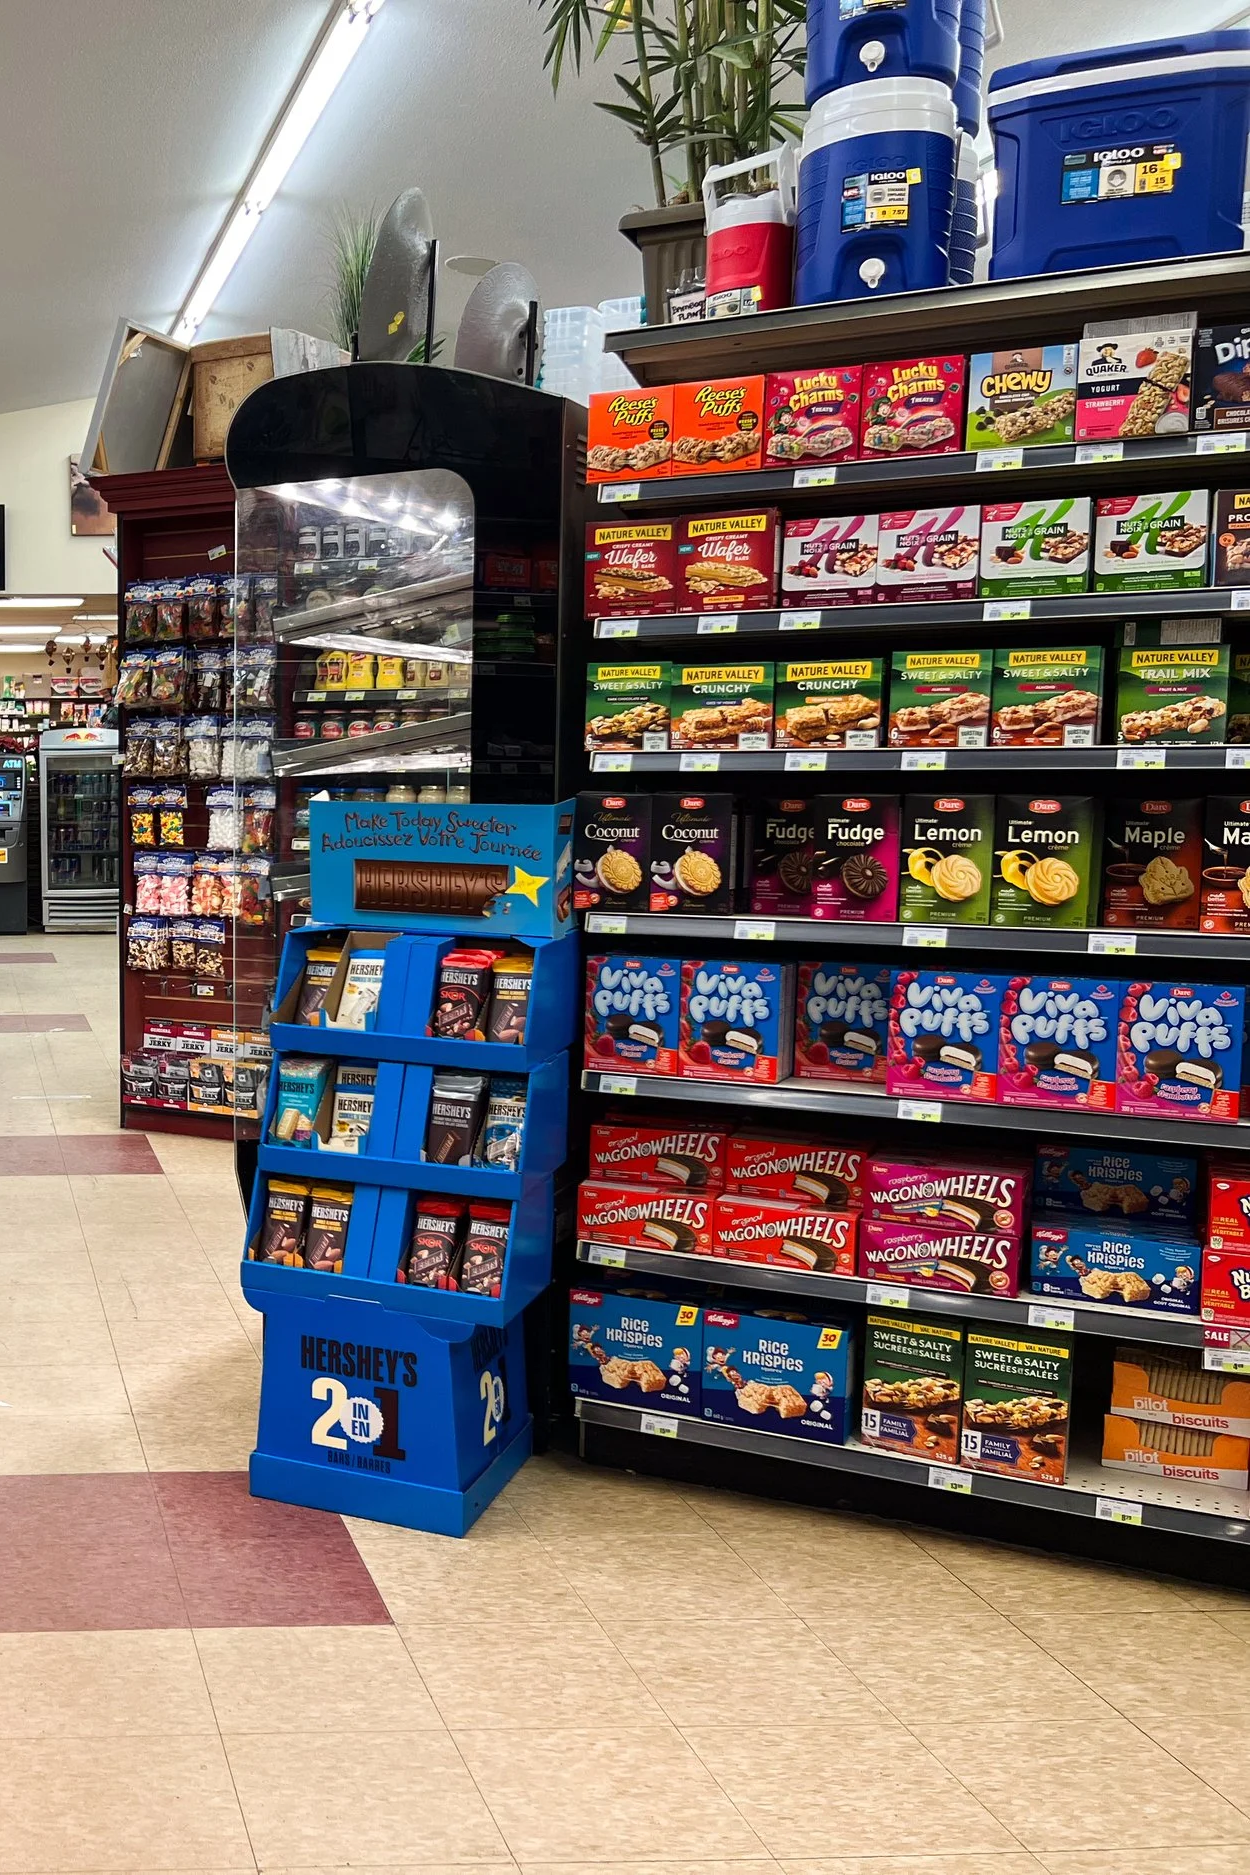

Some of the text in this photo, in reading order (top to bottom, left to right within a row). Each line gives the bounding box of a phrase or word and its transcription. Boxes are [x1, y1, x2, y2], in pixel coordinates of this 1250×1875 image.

[1061, 107, 1178, 143] IGLOO
[1094, 147, 1144, 162] IGLOO
[871, 172, 905, 181] IGLOO
[1142, 164, 1158, 174] 16
[892, 361, 938, 381] Lucky
[1086, 363, 1128, 376] QUAKER
[793, 373, 837, 391] Lucky
[1091, 384, 1120, 394] YOGURT
[695, 386, 746, 403] Reese's
[887, 378, 945, 403] Charms
[608, 396, 657, 413] Reese's
[789, 388, 844, 412] Charms
[1085, 398, 1124, 409] STRAWBERRY
[700, 401, 742, 418] Puffs
[614, 410, 654, 427] Puffs
[692, 518, 763, 533] NATURE VALLEY
[1034, 525, 1064, 535] GRAIN
[1150, 519, 1181, 529] GRAIN
[599, 527, 667, 541] NATURE VALLEY
[926, 534, 955, 543] GRAIN
[697, 542, 751, 561] Wafer
[829, 541, 856, 551] GRAIN
[605, 550, 657, 569] Wafer
[910, 656, 975, 665] NATURE VALLEY
[1013, 653, 1082, 664] NATURE VALLEY
[1136, 652, 1214, 663] NATURE VALLEY
[601, 667, 657, 677] NATURE VALLEY
[687, 669, 760, 681] NATURE VALLEY
[791, 665, 867, 677] NATURE VALLEY
[901, 671, 936, 680] SWEET
[949, 671, 982, 679] SALTY
[1003, 669, 1041, 678] SWEET
[1054, 667, 1089, 677] SALTY
[1139, 668, 1211, 679] TRAIL MIX
[594, 682, 625, 690] SWEET
[632, 681, 662, 690] SALTY
[693, 684, 751, 694] CRUNCHY
[797, 680, 858, 690] CRUNCHY
[891, 728, 898, 739] 6
[3, 760, 21, 768] ATM
[605, 799, 623, 807] Dare
[683, 799, 701, 807] Dare
[846, 801, 867, 809] Dare
[938, 801, 960, 810] Dare
[1033, 802, 1057, 811] Dare
[344, 812, 518, 837] Make Today Sweeter
[585, 824, 640, 841] Coconut
[662, 825, 719, 842] Coconut
[766, 824, 814, 843] Fudge
[827, 824, 884, 845] Fudge
[914, 825, 982, 841] Lemon
[1008, 826, 1079, 843] Lemon
[1125, 827, 1185, 848] Maple
[321, 829, 543, 862] Adoucissez Votre Journée
[356, 865, 505, 909] HERSHEY'S
[441, 972, 478, 986] HERSHEY'S
[433, 1103, 471, 1118] HERSHEY'S
[596, 1133, 720, 1164] WAGON WHEELS
[731, 1151, 861, 1181] WAGON WHEELS
[870, 1175, 1015, 1208] WAGON WHEELS
[582, 1199, 707, 1229] WAGON WHEELS
[718, 1216, 849, 1248] WAGON WHEELS
[865, 1236, 1011, 1270] WAGON WHEELS
[681, 1311, 693, 1320] 30
[822, 1334, 836, 1343] 30
[874, 1331, 951, 1352] SWEET & SALTY
[1205, 1330, 1229, 1342] SALE
[874, 1340, 951, 1362] SUCRÉES SALÉES
[301, 1335, 418, 1388] HERSHEY'S
[975, 1350, 1060, 1371] SWEET & SALTY
[975, 1360, 1059, 1381] SUCRÉES SALÉES
[660, 1393, 690, 1403] ORIGINAL
[1133, 1397, 1169, 1412] pilot
[311, 1376, 348, 1450] 2
[352, 1403, 368, 1420] IN
[800, 1419, 834, 1430] ORIGINAL
[864, 1412, 877, 1429] 15
[883, 1418, 907, 1429] FAMILY
[1172, 1413, 1229, 1429] biscuits
[352, 1420, 370, 1438] EN
[880, 1426, 909, 1438] FAMILIAL
[964, 1434, 977, 1450] 15
[985, 1439, 1011, 1450] FAMILY
[982, 1448, 1013, 1459] FAMILIAL
[1124, 1450, 1160, 1464] pilot
[1162, 1465, 1219, 1481] biscuits
